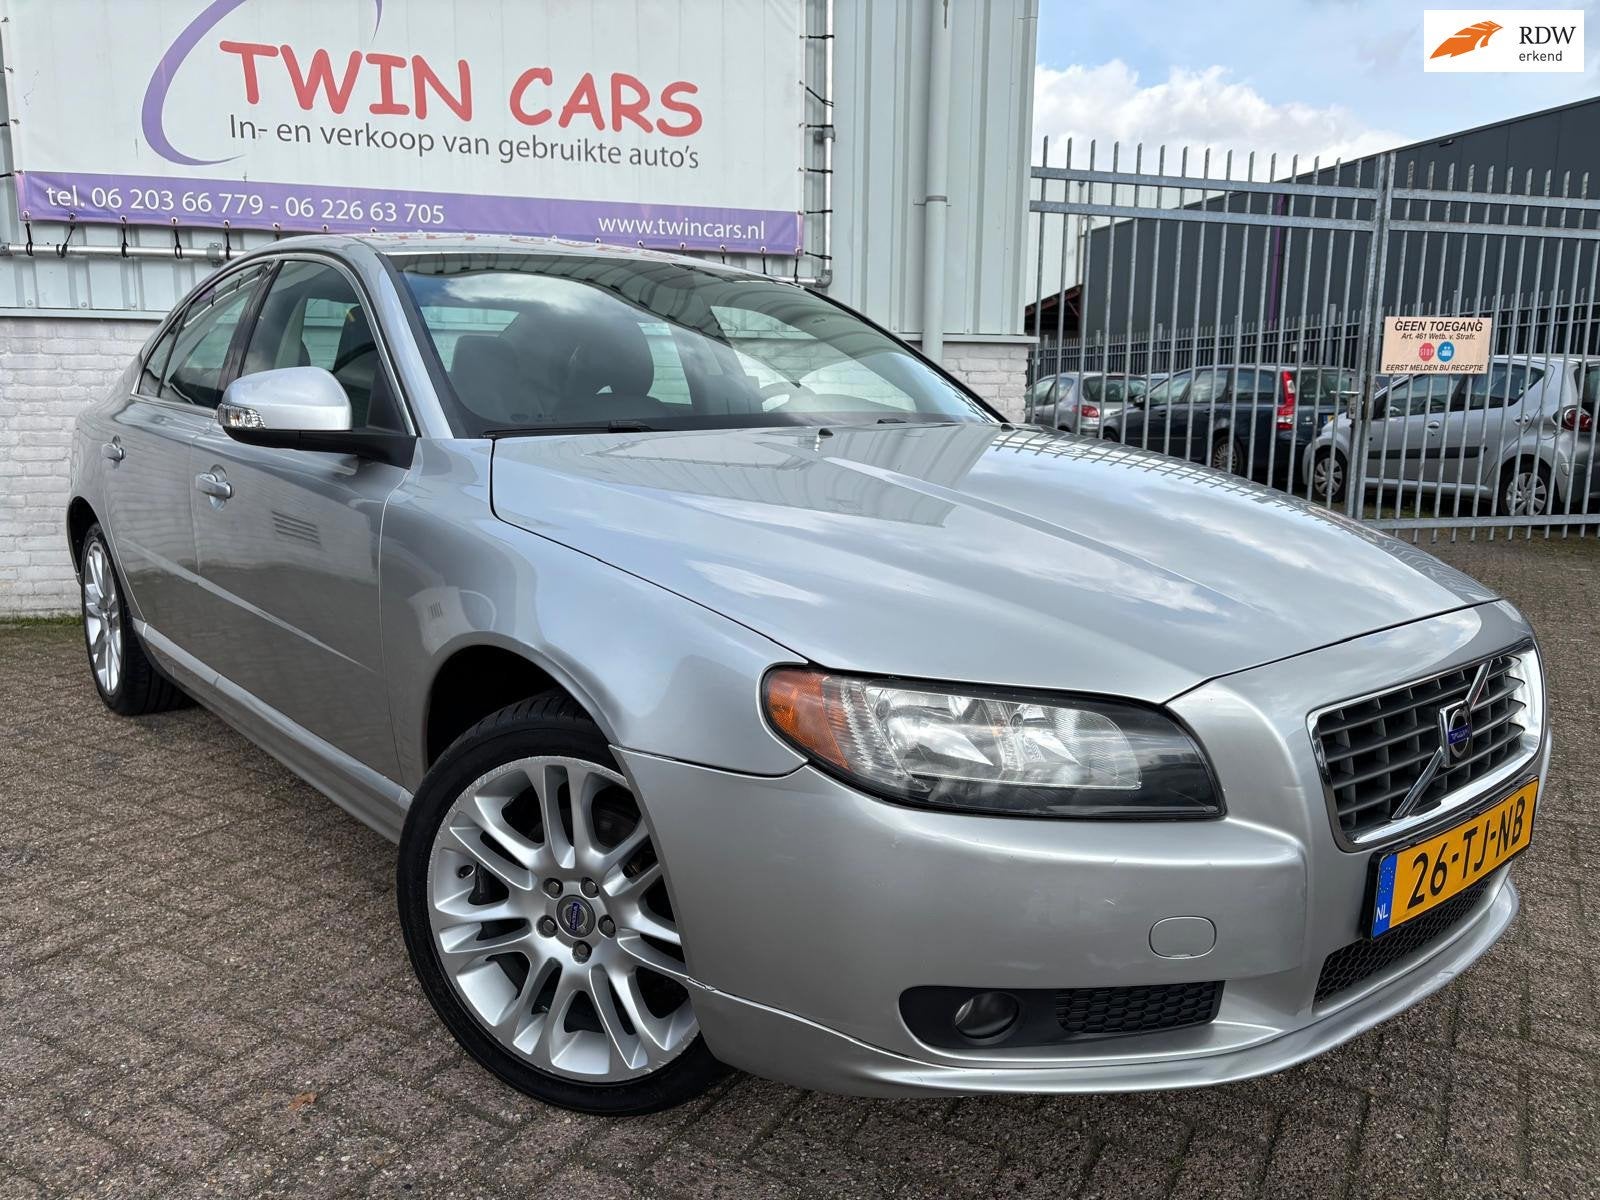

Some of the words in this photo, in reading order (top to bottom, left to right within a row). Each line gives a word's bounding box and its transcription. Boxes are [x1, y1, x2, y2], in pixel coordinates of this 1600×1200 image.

[219, 40, 473, 122] TWIN
[509, 67, 703, 137] CARS
[229, 114, 268, 139] In-
[276, 120, 311, 143] en
[319, 123, 435, 157] verkoop
[442, 134, 490, 155] van
[498, 135, 622, 164] gebruikte
[629, 145, 700, 169] auto's
[46, 185, 86, 208] tel.
[91, 187, 122, 210] 06
[129, 189, 175, 211] 203
[182, 192, 212, 213] 66
[218, 193, 264, 215] 779
[285, 197, 314, 218] 06
[321, 199, 364, 220] 226
[370, 201, 397, 222] 63
[404, 204, 445, 225] 705
[598, 215, 765, 241] www.twincars.nl
[1394, 321, 1427, 332] GEEN
[1430, 321, 1483, 332] TOEGANG
[1407, 796, 1525, 909] 26-TJ-NB
[1375, 905, 1389, 923] NL
